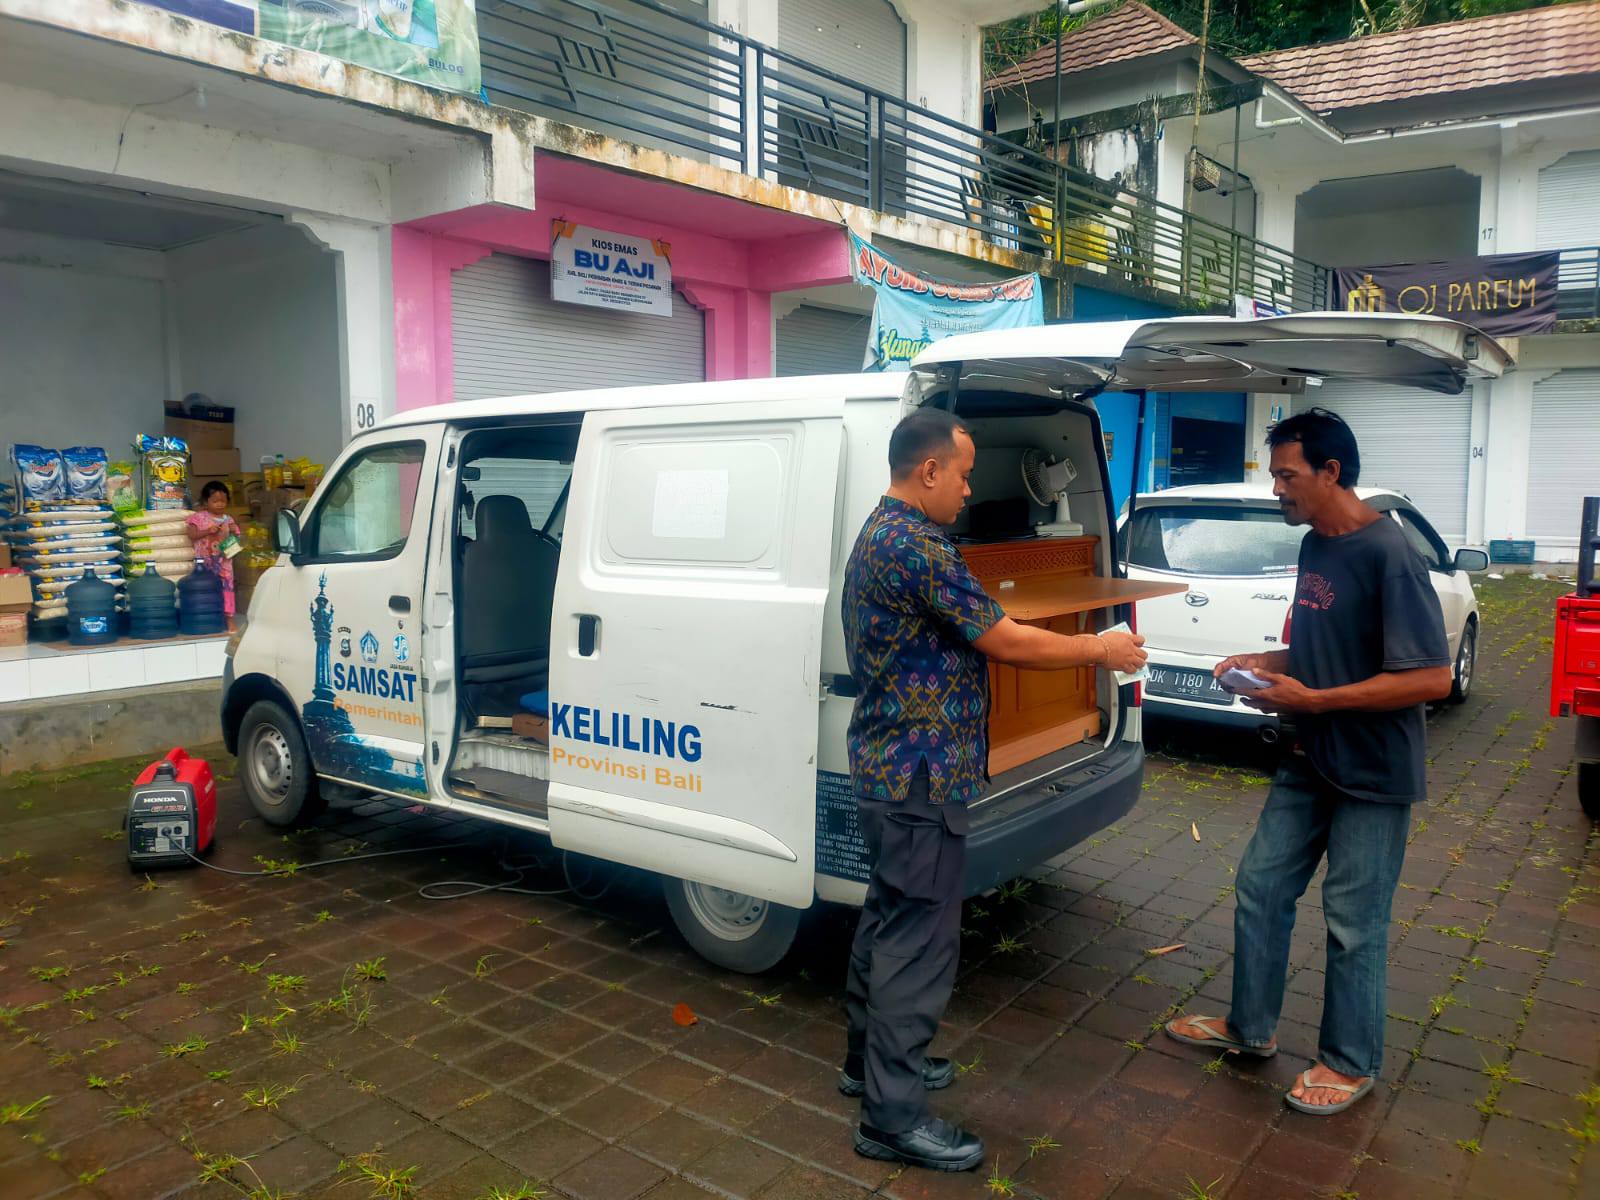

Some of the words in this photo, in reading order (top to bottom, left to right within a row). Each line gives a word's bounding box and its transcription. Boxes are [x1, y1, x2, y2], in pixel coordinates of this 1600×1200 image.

[428, 58, 464, 74] BULOG
[592, 238, 613, 251] KIOS
[614, 243, 638, 256] EMAS
[1482, 228, 1493, 240] 17
[574, 249, 610, 272] BU
[613, 258, 655, 280] AJI
[1398, 284, 1437, 314] OJ
[1447, 278, 1536, 312] PARFUM
[357, 402, 375, 428] 08
[1472, 446, 1483, 458] 04
[333, 662, 417, 703] SAMSAT
[1151, 669, 1166, 684] DK
[1174, 672, 1203, 688] 1180
[333, 698, 423, 728] Pemerintah
[552, 702, 702, 763] KELILING
[553, 747, 646, 783] Provinsi
[655, 767, 702, 793] Bali
